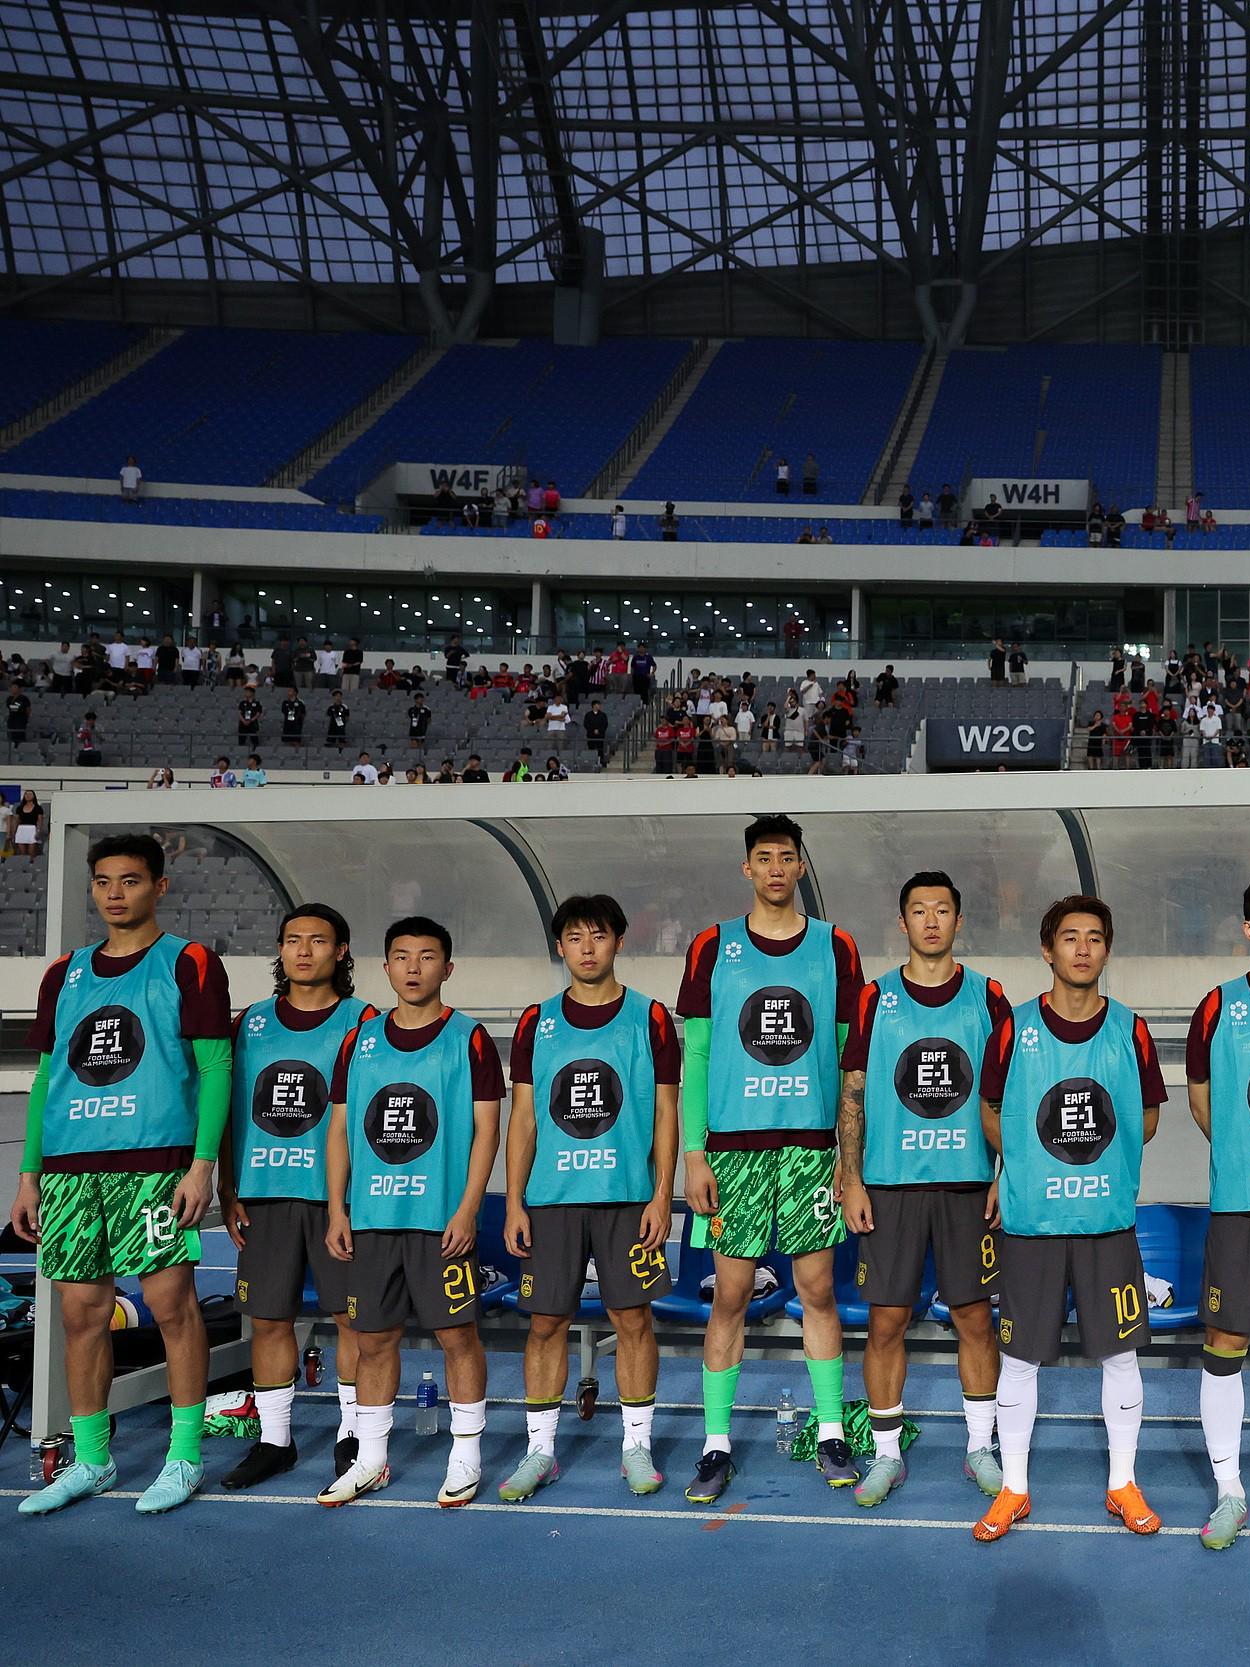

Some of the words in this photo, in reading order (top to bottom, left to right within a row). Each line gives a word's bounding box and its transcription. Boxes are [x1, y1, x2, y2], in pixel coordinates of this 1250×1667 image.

[430, 468, 490, 491] W4F
[1001, 482, 1060, 504] W4H
[957, 724, 1036, 753] W2C
[764, 1000, 790, 1010] EAFF
[95, 1019, 120, 1031] EAFF
[761, 1012, 795, 1033] E-1
[90, 1031, 122, 1054] E-1
[921, 1052, 947, 1062] EAFF
[278, 1073, 304, 1083] EAFF
[574, 1072, 599, 1083] EAFF
[918, 1064, 952, 1086] E-1
[272, 1085, 306, 1106] E-1
[570, 1084, 603, 1107] E-1
[744, 1076, 809, 1097] 2025
[70, 1095, 136, 1120] 2025
[388, 1097, 414, 1108] EAFF
[1064, 1092, 1091, 1105] EAFF
[383, 1110, 416, 1131] E-1
[563, 1112, 610, 1120] CHAMPIONSHIP
[1061, 1106, 1096, 1130] E-1
[902, 1129, 967, 1151] 2025
[250, 1148, 316, 1168] 2025
[557, 1149, 616, 1171] 2025
[370, 1175, 427, 1196] 2025
[1046, 1175, 1110, 1199] 2025
[140, 1205, 175, 1244] 12
[628, 1243, 665, 1279] 24
[980, 1234, 996, 1269] 8
[442, 1261, 476, 1300] 21
[1110, 1283, 1141, 1325] 10
